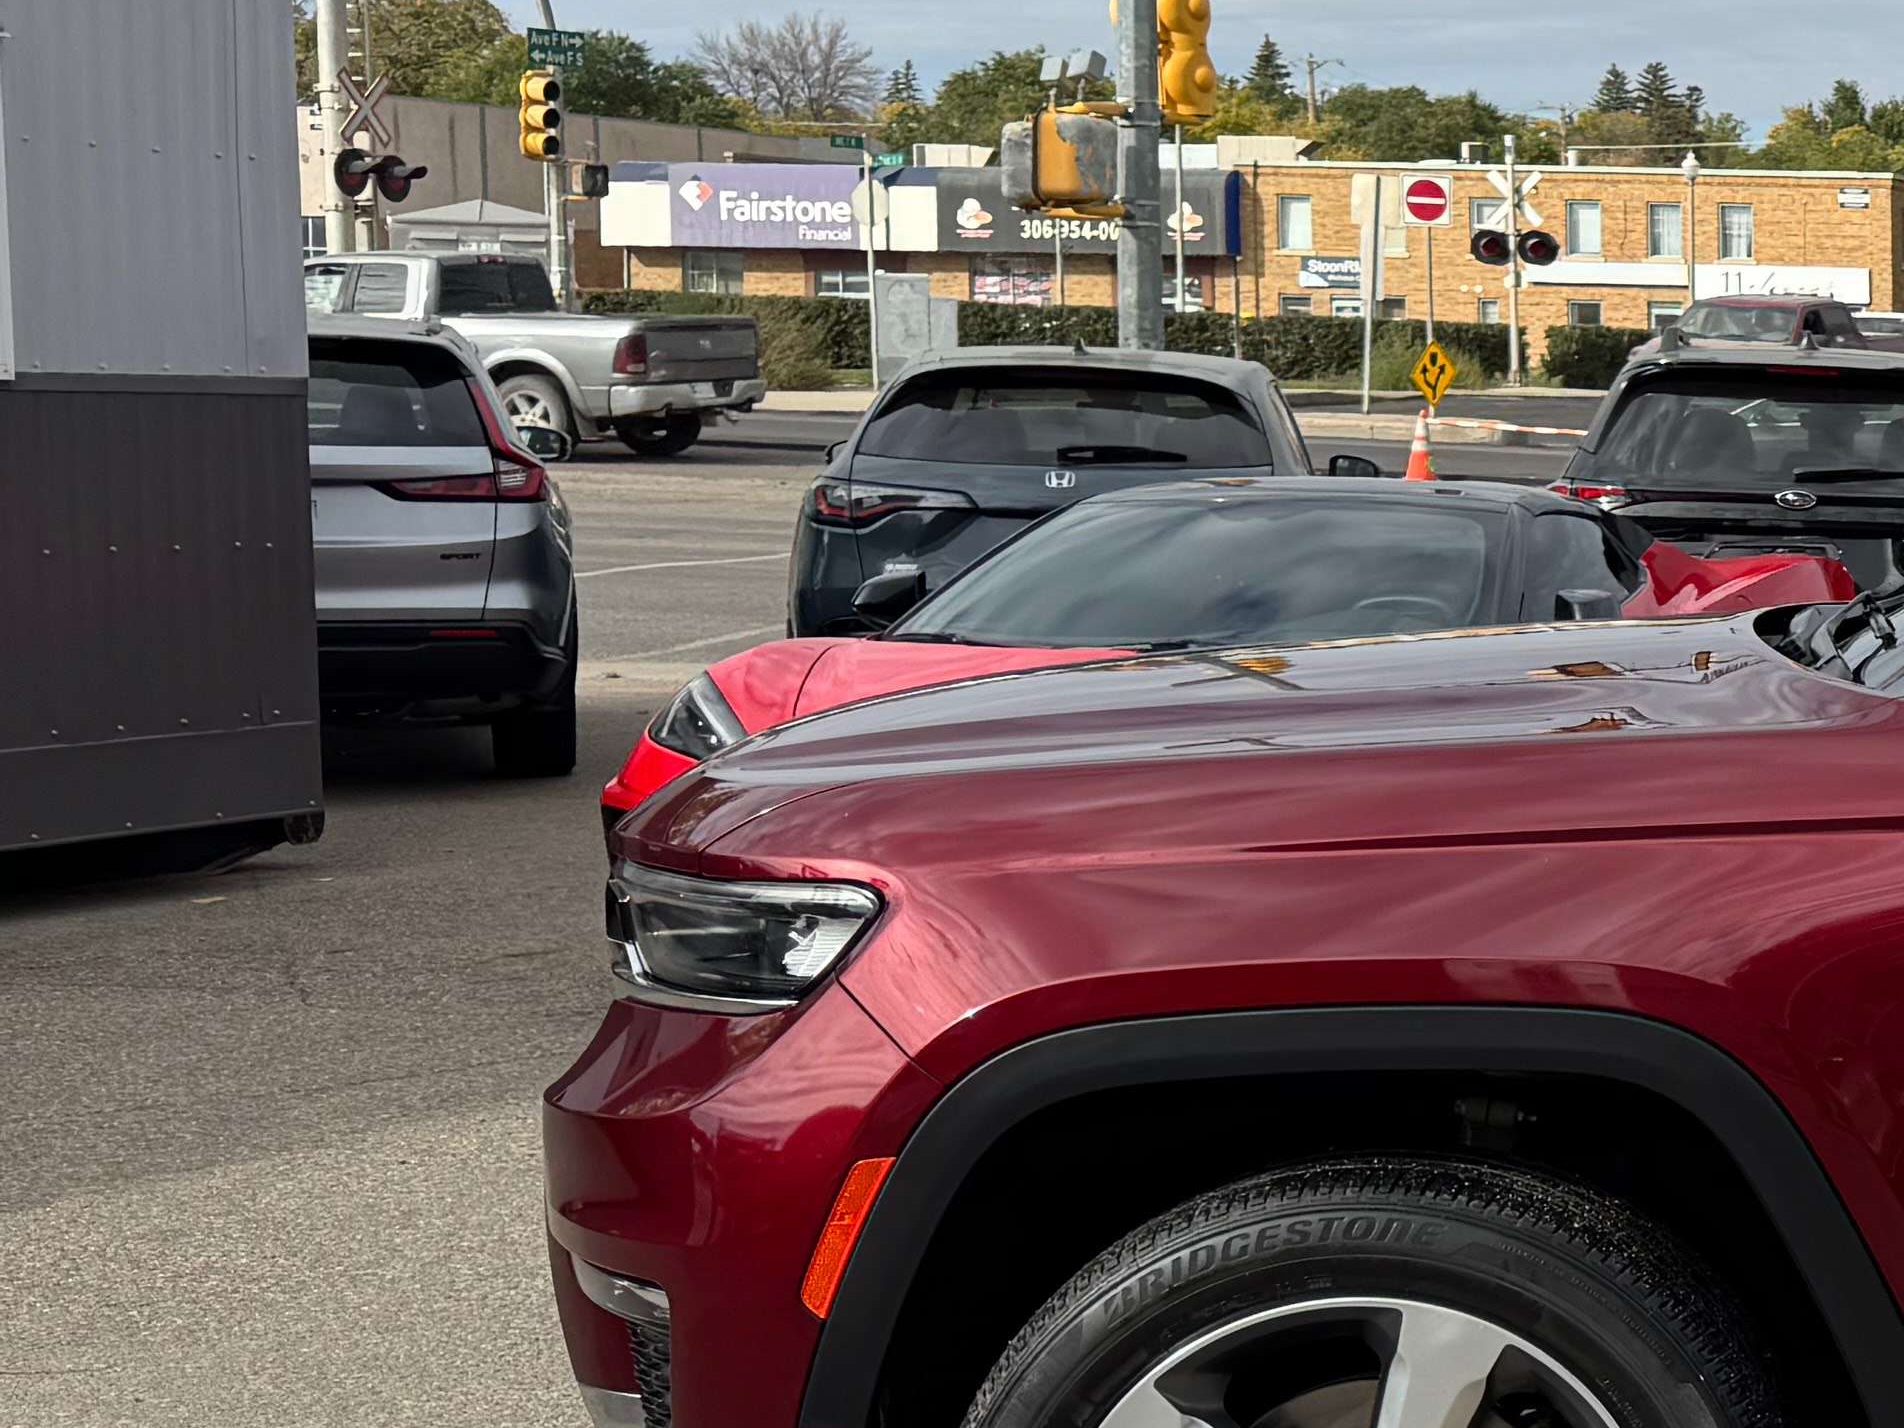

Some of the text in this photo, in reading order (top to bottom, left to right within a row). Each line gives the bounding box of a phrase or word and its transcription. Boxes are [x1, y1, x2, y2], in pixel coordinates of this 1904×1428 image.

[531, 31, 550, 46] Ave
[719, 190, 851, 223] Fairstone
[799, 225, 852, 242] Financial
